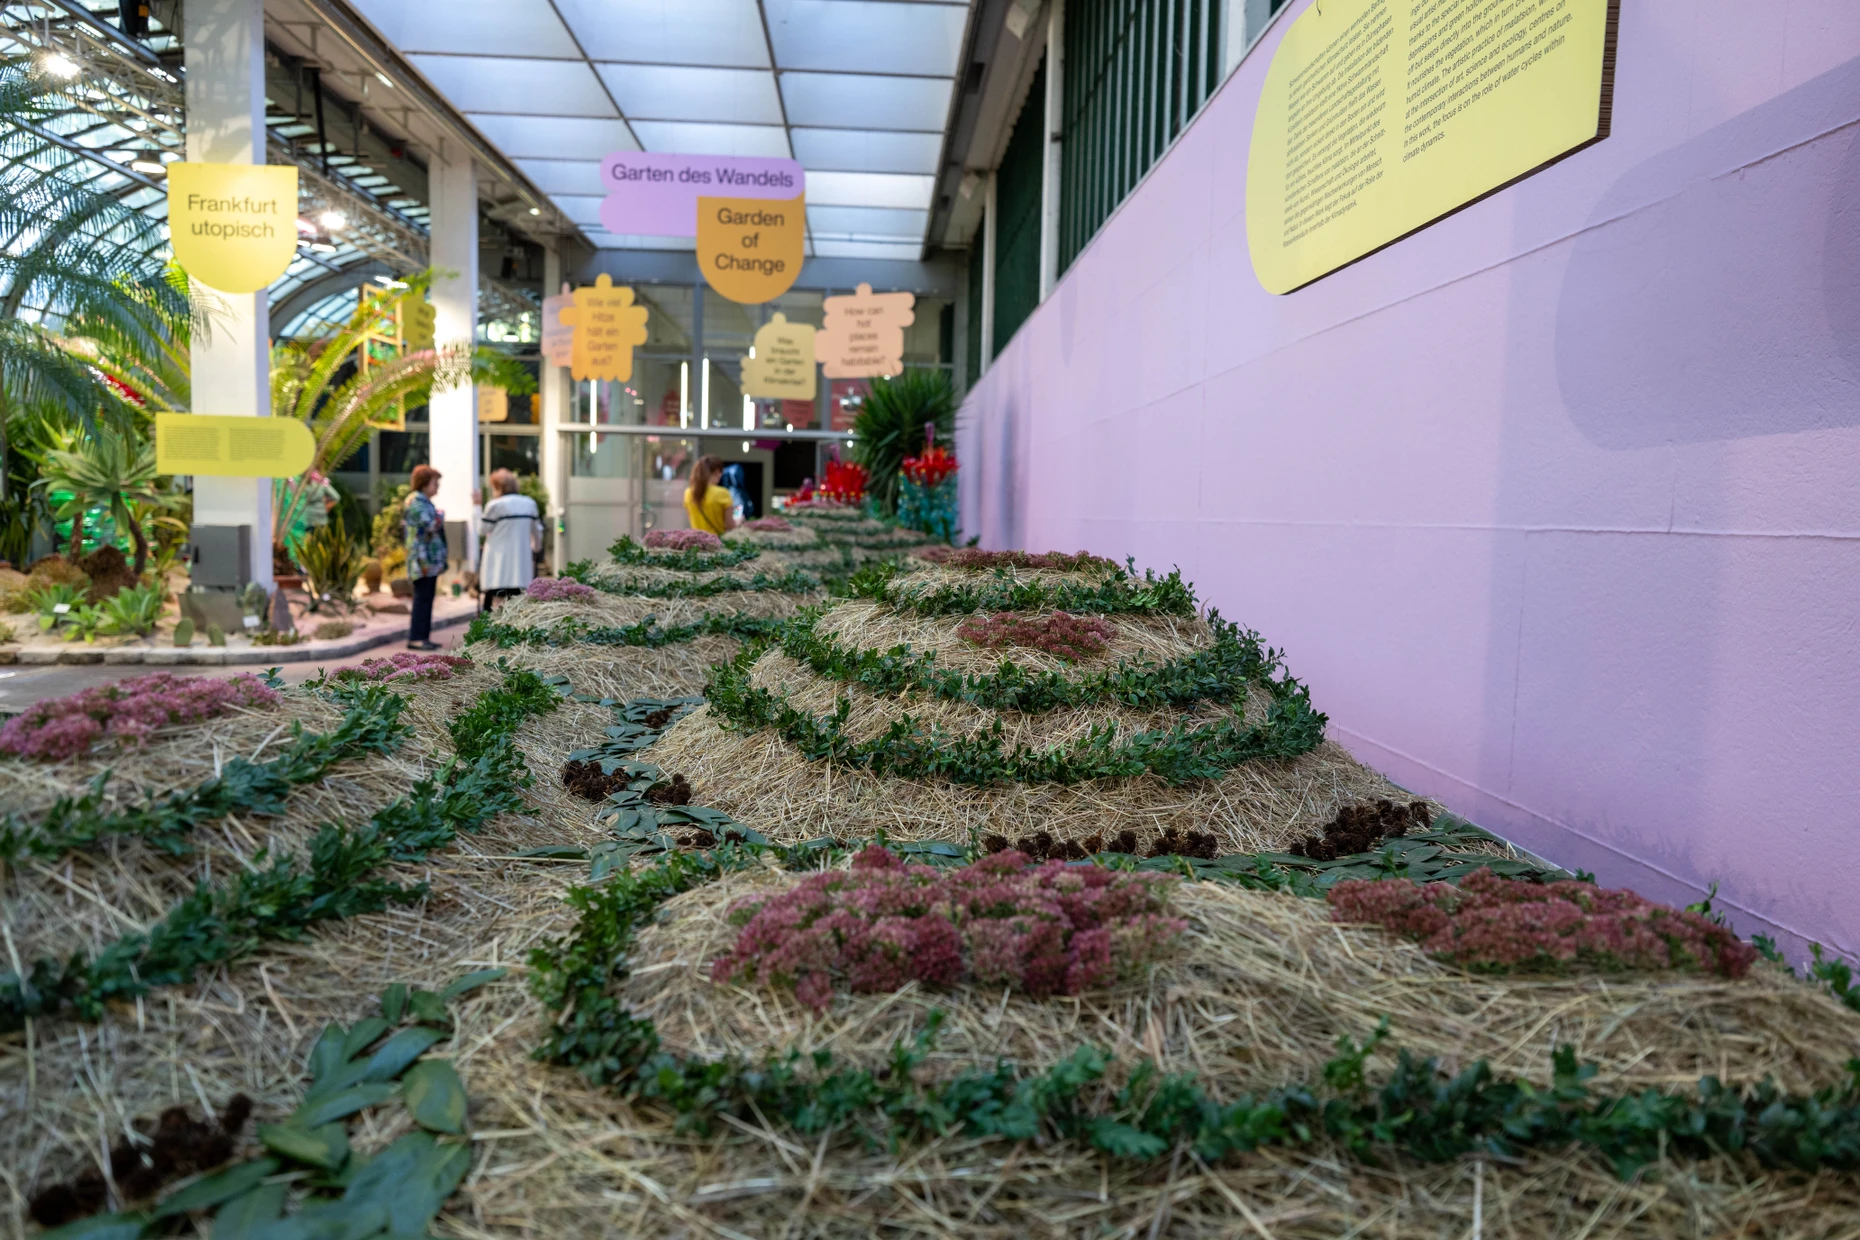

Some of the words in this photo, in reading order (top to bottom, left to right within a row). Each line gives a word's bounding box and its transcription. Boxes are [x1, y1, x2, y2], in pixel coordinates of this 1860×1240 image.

[1409, 12, 1423, 31] visual
[1424, 1, 1436, 19] artist
[1410, 2, 1420, 16] ings
[1408, 32, 1436, 60] depressions
[1437, 21, 1447, 36] and
[1448, 10, 1463, 30] green
[1409, 27, 1424, 46] thanks
[1425, 22, 1430, 32] to
[1441, 0, 1459, 19] special
[1406, 86, 1420, 104] humid
[1421, 74, 1440, 93] climate.
[1442, 65, 1451, 77] The
[1453, 51, 1471, 70] artistic
[1472, 33, 1495, 58] practice
[1496, 25, 1502, 38] of
[1504, 3, 1536, 32] malatsion,
[1407, 80, 1410, 89] It
[1411, 64, 1433, 86] nourishes
[1435, 56, 1443, 68] the
[1444, 34, 1474, 61] vegetation,
[1476, 17, 1492, 37] which
[1493, 13, 1499, 24] in
[1501, 3, 1513, 18] turn
[1415, 56, 1423, 69] but
[1424, 45, 1438, 62] seeps
[1440, 29, 1459, 50] directly
[1460, 20, 1470, 34] into
[1472, 11, 1481, 24] the
[1405, 108, 1410, 118] at
[1420, 82, 1448, 108] intersection
[1450, 76, 1455, 87] of
[1456, 69, 1465, 82] art,
[1467, 54, 1487, 75] science
[1489, 43, 1500, 59] and
[1502, 26, 1527, 50] ecology,
[1529, 6, 1554, 30] centres
[1556, 0, 1565, 11] on
[1413, 99, 1446, 127] contemporary
[1447, 76, 1478, 104] interactions
[1480, 58, 1505, 81] between
[1507, 40, 1531, 63] humans
[1533, 27, 1545, 45] and
[1548, 13, 1572, 35] nature.
[1404, 139, 1408, 148] In
[1409, 133, 1417, 144] this
[1419, 123, 1431, 137] work,
[1433, 117, 1441, 128] the
[1442, 107, 1456, 122] focus
[1457, 103, 1462, 112] is
[1463, 98, 1470, 108] on
[1472, 91, 1480, 103] the
[1482, 82, 1493, 96] role
[1495, 75, 1501, 87] of
[1502, 64, 1519, 82] water
[1521, 50, 1541, 70] cycles
[1544, 35, 1564, 55] within
[1403, 146, 1419, 162] climate
[1420, 131, 1445, 152] dynamics.
[611, 163, 674, 182] Garten
[678, 167, 712, 184] des
[716, 168, 794, 188] Wandels
[188, 194, 277, 214] Frankfurt
[717, 207, 785, 226] Garden
[191, 220, 275, 240] utopisch
[741, 232, 760, 249] of
[714, 253, 785, 276] Change
[844, 307, 864, 316] How
[867, 307, 884, 315] can
[587, 340, 618, 351] Garten
[849, 332, 878, 342] places
